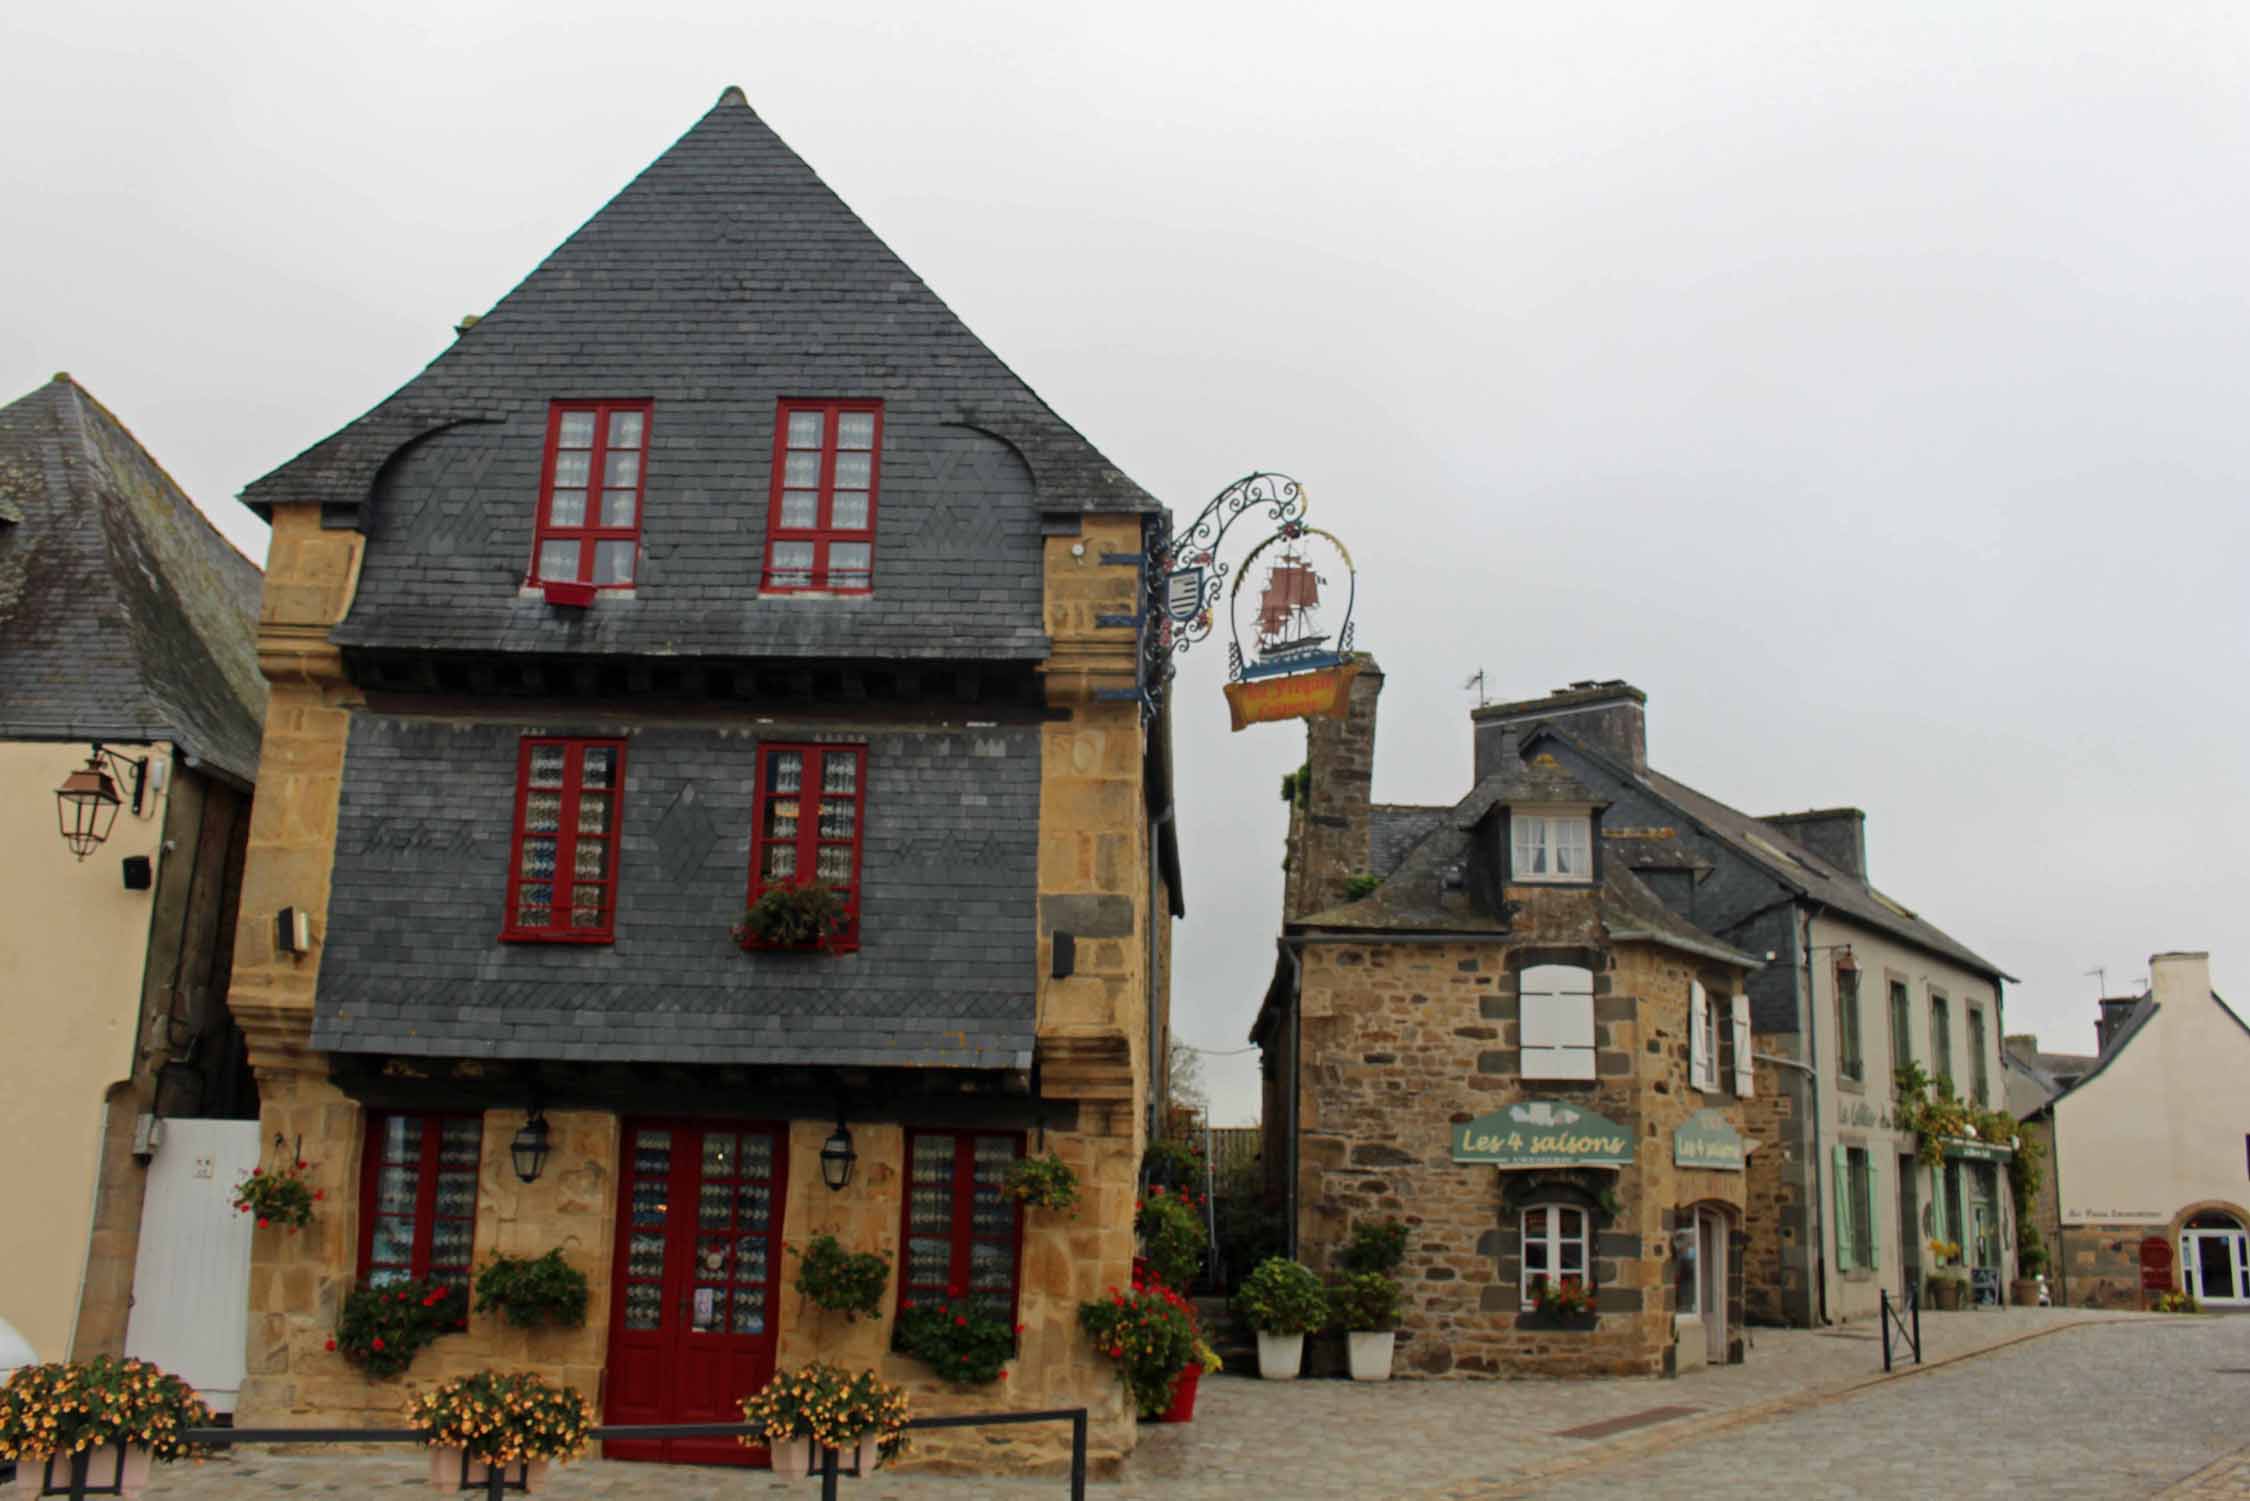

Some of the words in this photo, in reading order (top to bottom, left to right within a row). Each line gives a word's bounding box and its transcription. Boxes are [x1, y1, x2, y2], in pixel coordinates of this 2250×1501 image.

[1462, 1129, 1503, 1154] Les
[1507, 1132, 1524, 1151] 4
[1530, 1131, 1626, 1154] saisons
